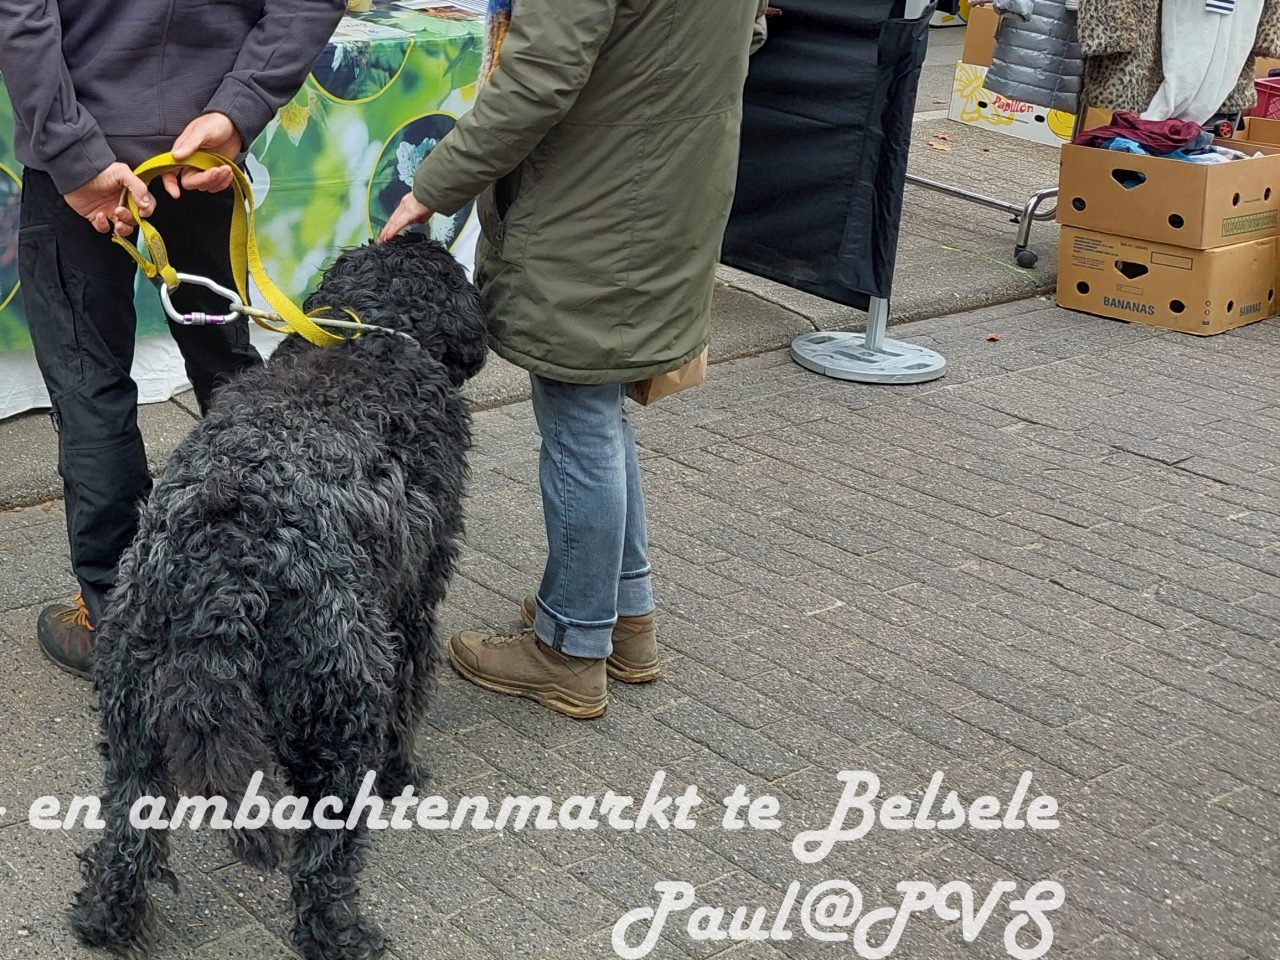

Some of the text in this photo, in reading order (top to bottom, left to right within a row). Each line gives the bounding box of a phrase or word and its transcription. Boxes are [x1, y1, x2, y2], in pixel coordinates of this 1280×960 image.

[991, 95, 1035, 113] Papillon
[1103, 296, 1155, 316] BANANAS
[1239, 302, 1263, 317] BANANAS
